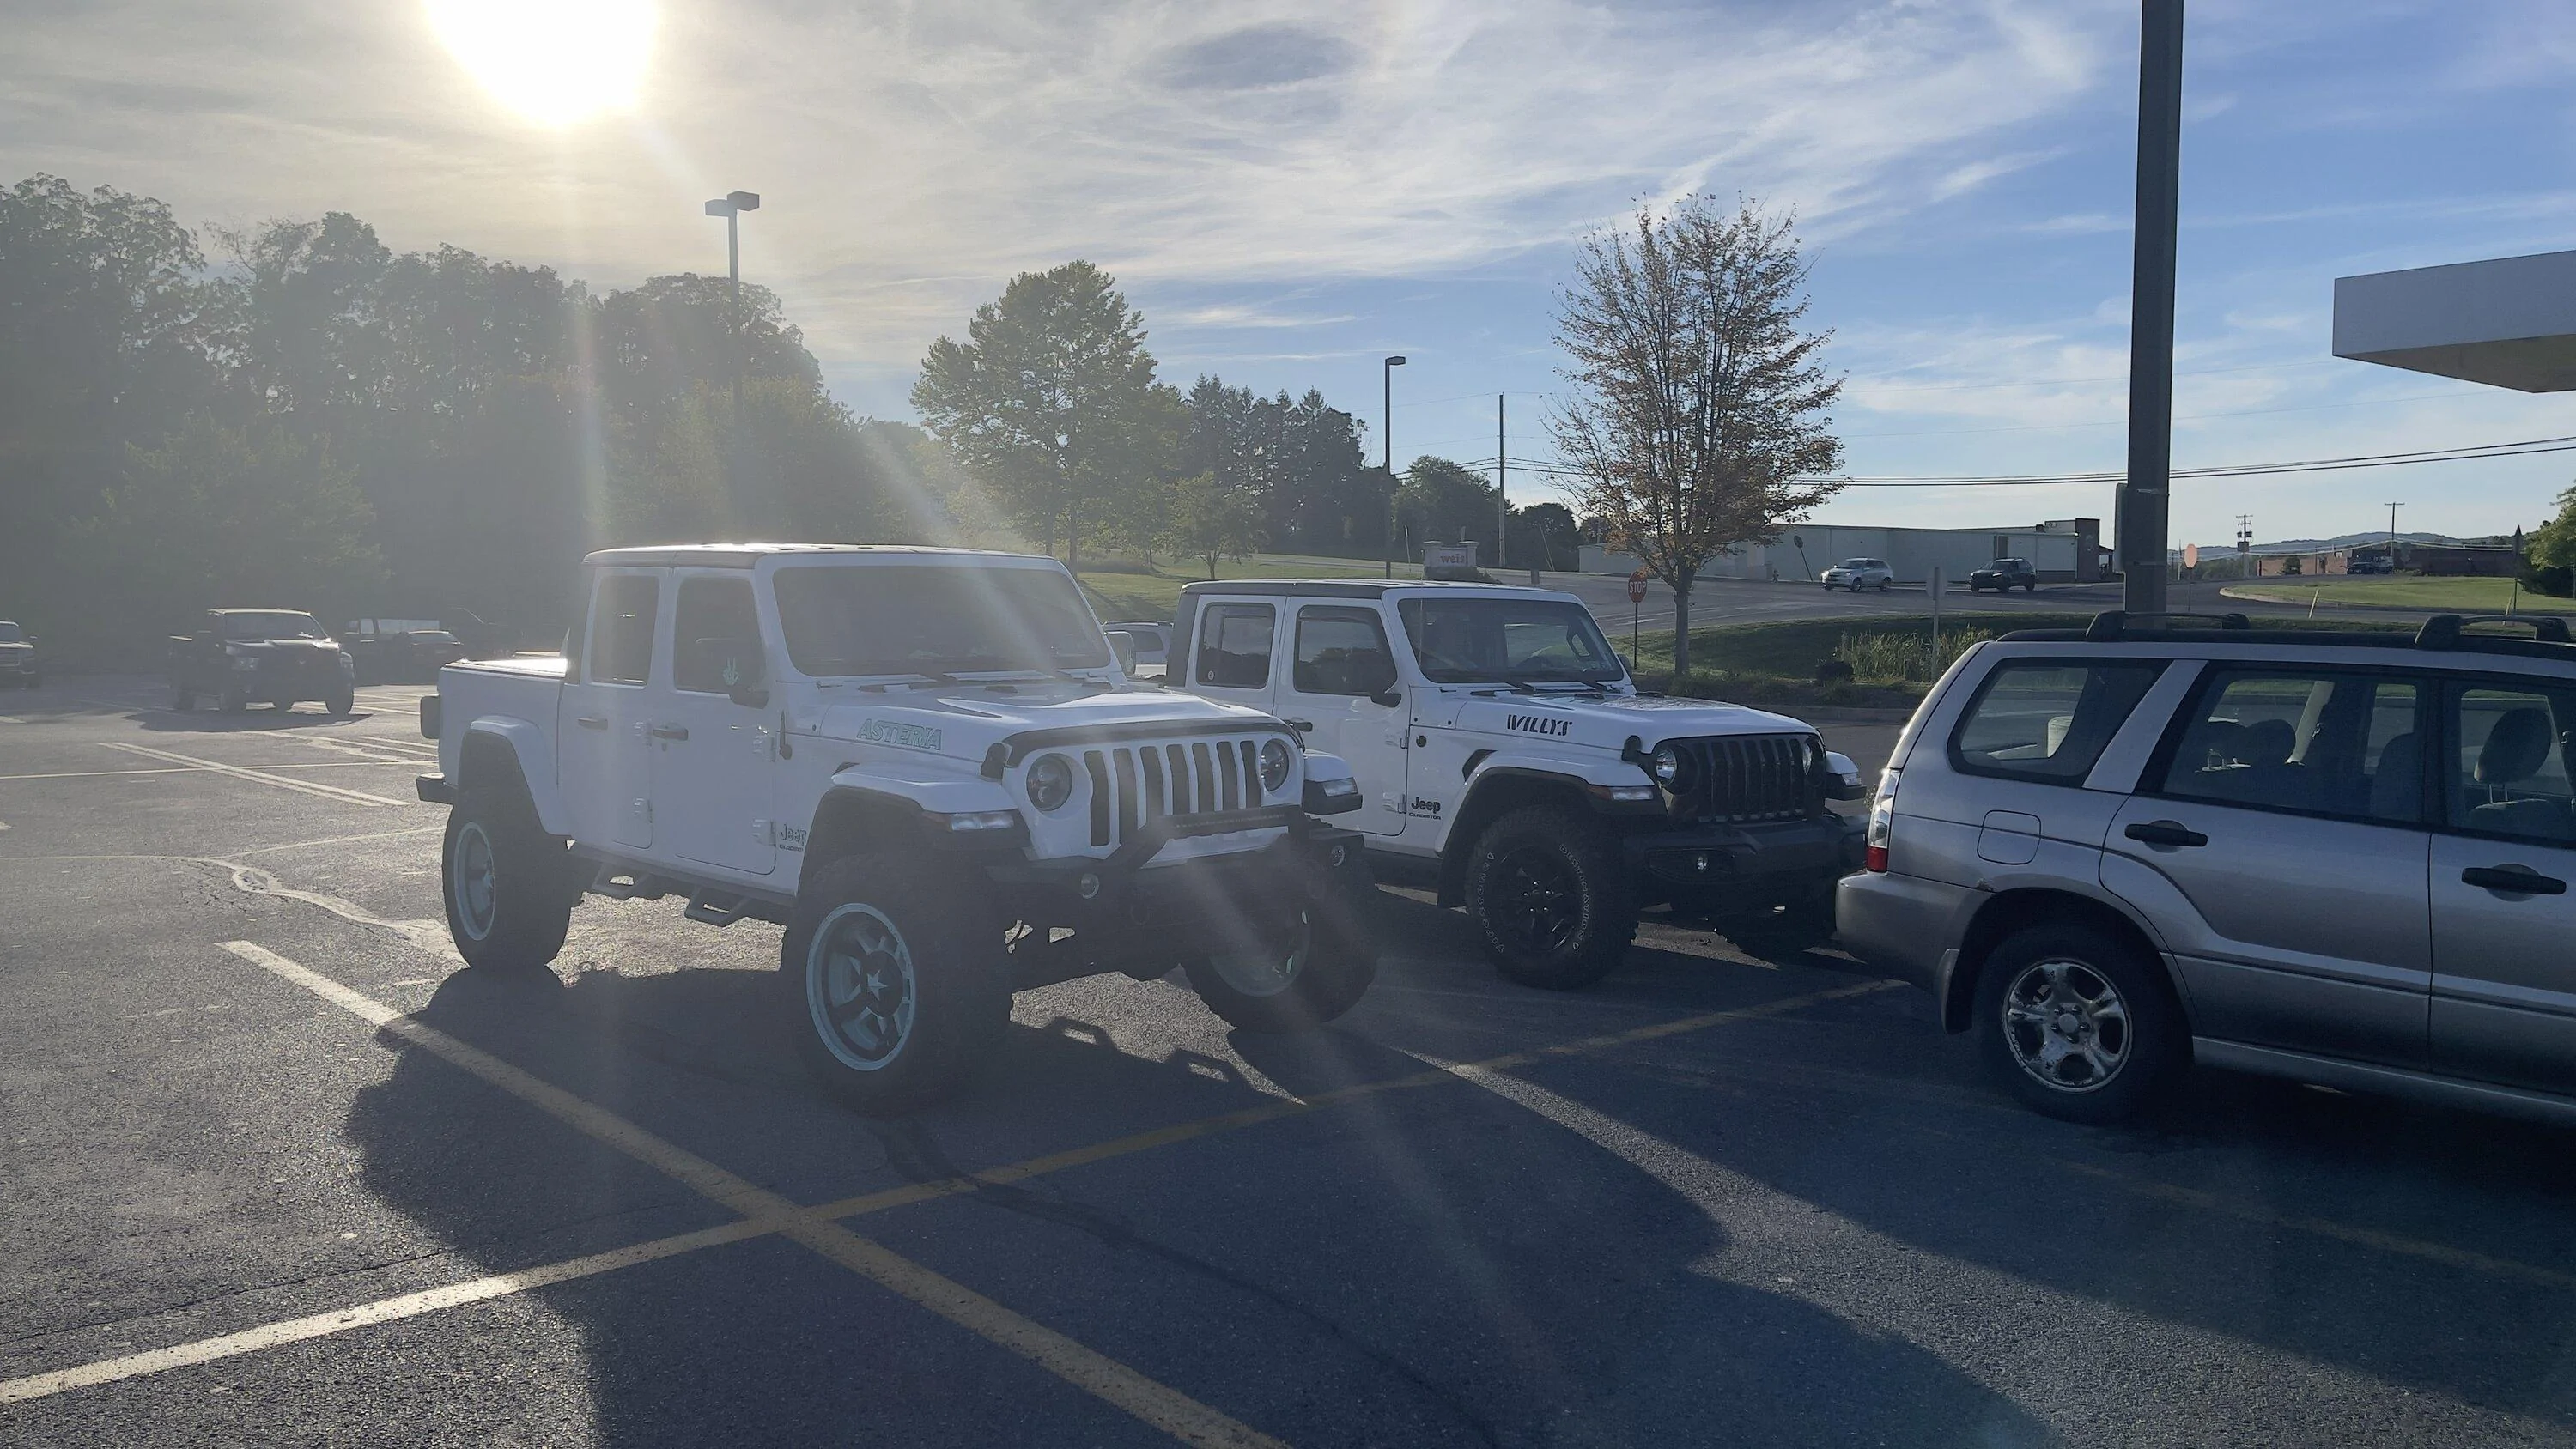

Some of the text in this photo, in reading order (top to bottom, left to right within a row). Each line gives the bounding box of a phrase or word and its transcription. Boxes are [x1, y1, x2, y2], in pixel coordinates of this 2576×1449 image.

[1629, 581, 1647, 593] STOP
[856, 718, 942, 751] ASTERIA
[1507, 714, 1573, 736] WILLYS
[1411, 797, 1441, 814] Jeep
[780, 823, 807, 846] Jeep
